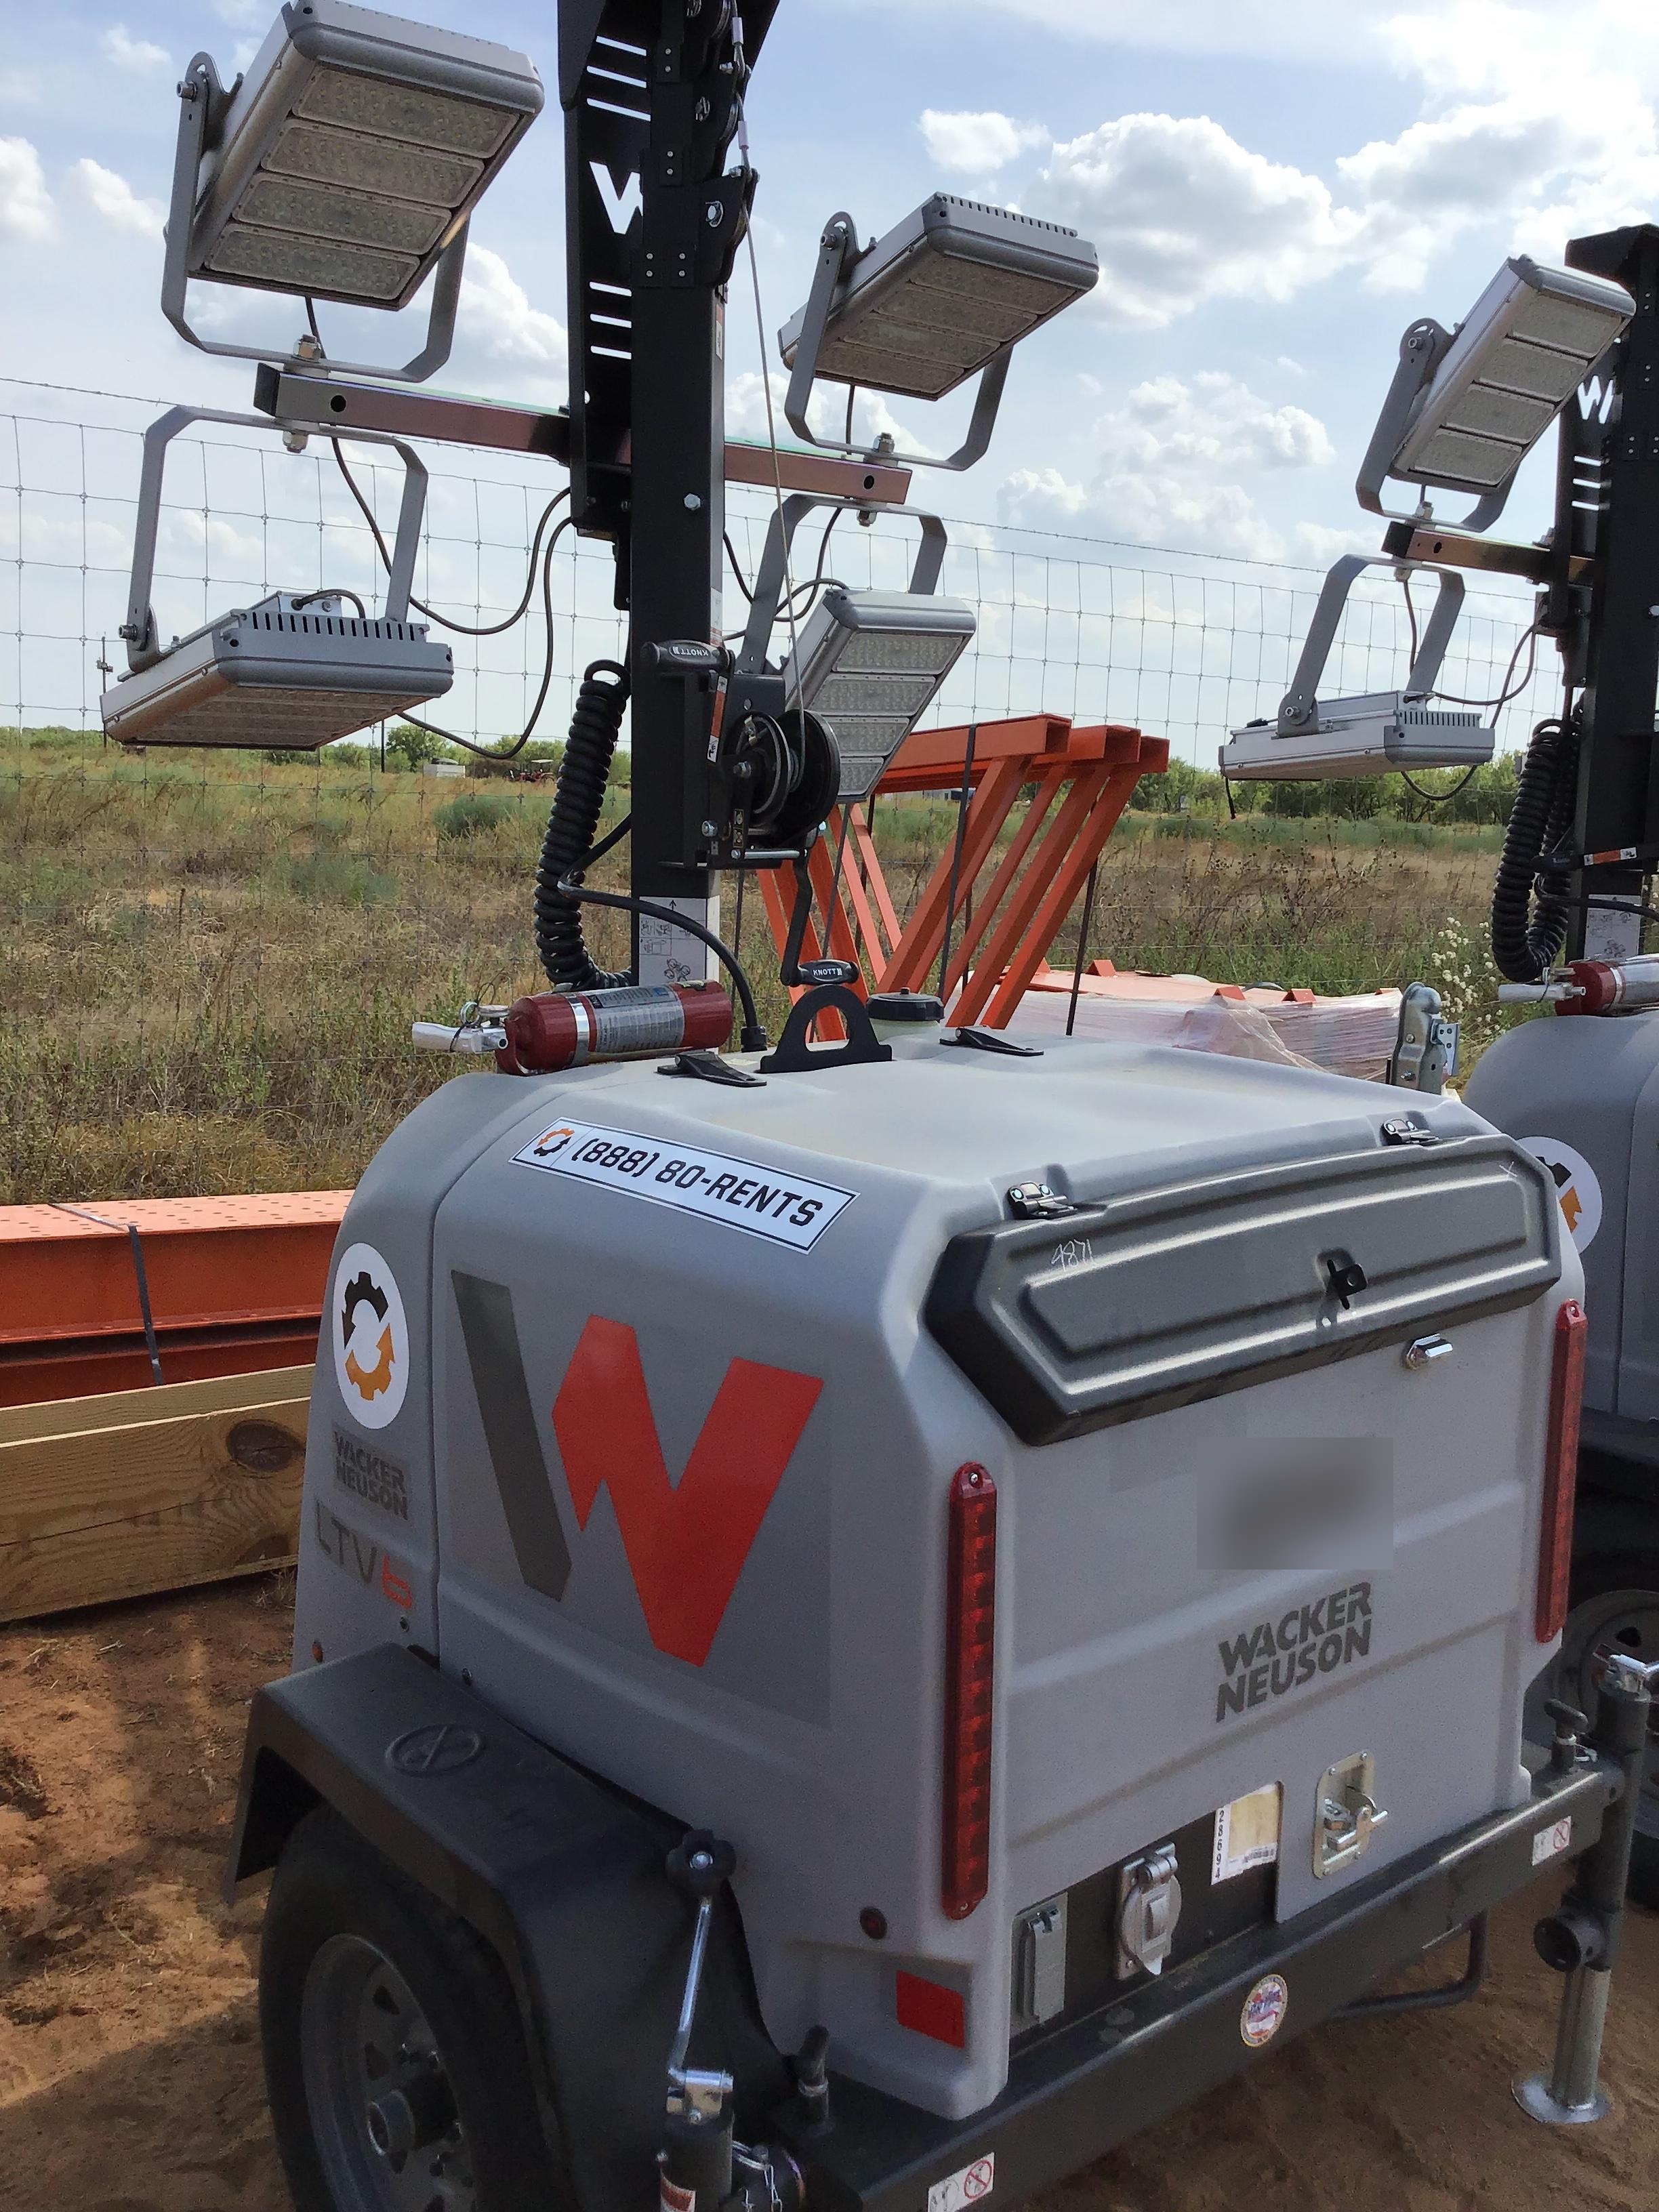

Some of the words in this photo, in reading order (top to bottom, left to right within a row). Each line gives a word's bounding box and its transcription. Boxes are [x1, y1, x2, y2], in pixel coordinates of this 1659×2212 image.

[681, 649, 709, 657] KNOTT
[813, 968, 836, 976] KNOTT
[571, 1138, 659, 1177] (888)
[655, 1160, 823, 1227] 80-RENTS
[335, 1431, 406, 1494] WACKER
[336, 1456, 408, 1520] NEUSON
[316, 1496, 413, 1610] LTV6
[1218, 1582, 1372, 1676] WACKER
[1216, 1618, 1372, 1723] NEUSON
